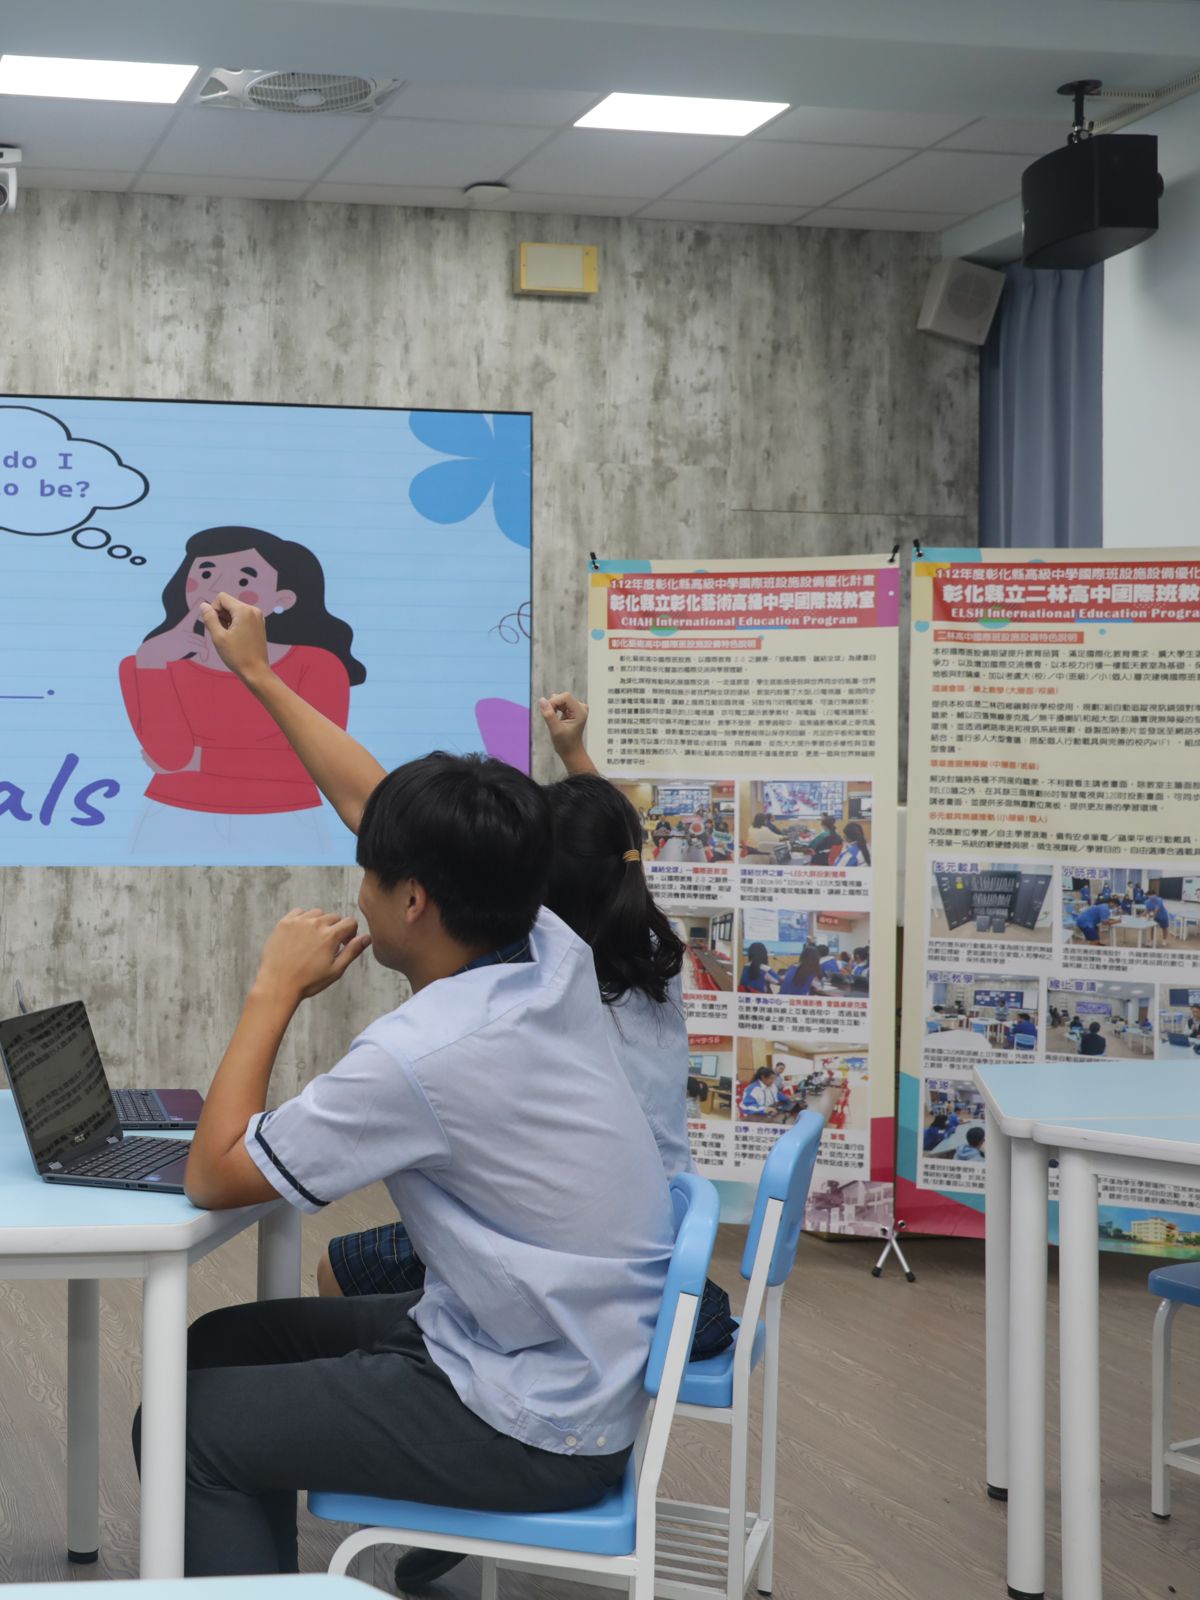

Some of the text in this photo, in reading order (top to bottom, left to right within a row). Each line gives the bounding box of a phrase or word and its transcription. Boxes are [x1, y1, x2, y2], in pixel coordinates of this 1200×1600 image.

[2, 450, 38, 468] do
[58, 452, 73, 470] I
[39, 479, 91, 498] be?
[951, 608, 983, 618] ELSH
[987, 608, 1075, 618] International
[1079, 608, 1148, 618] Education
[621, 615, 858, 627] CHAH International Education Program
[933, 861, 980, 874] 多元載具
[928, 972, 974, 984] 線上教學
[1048, 979, 1097, 992] 線上會議
